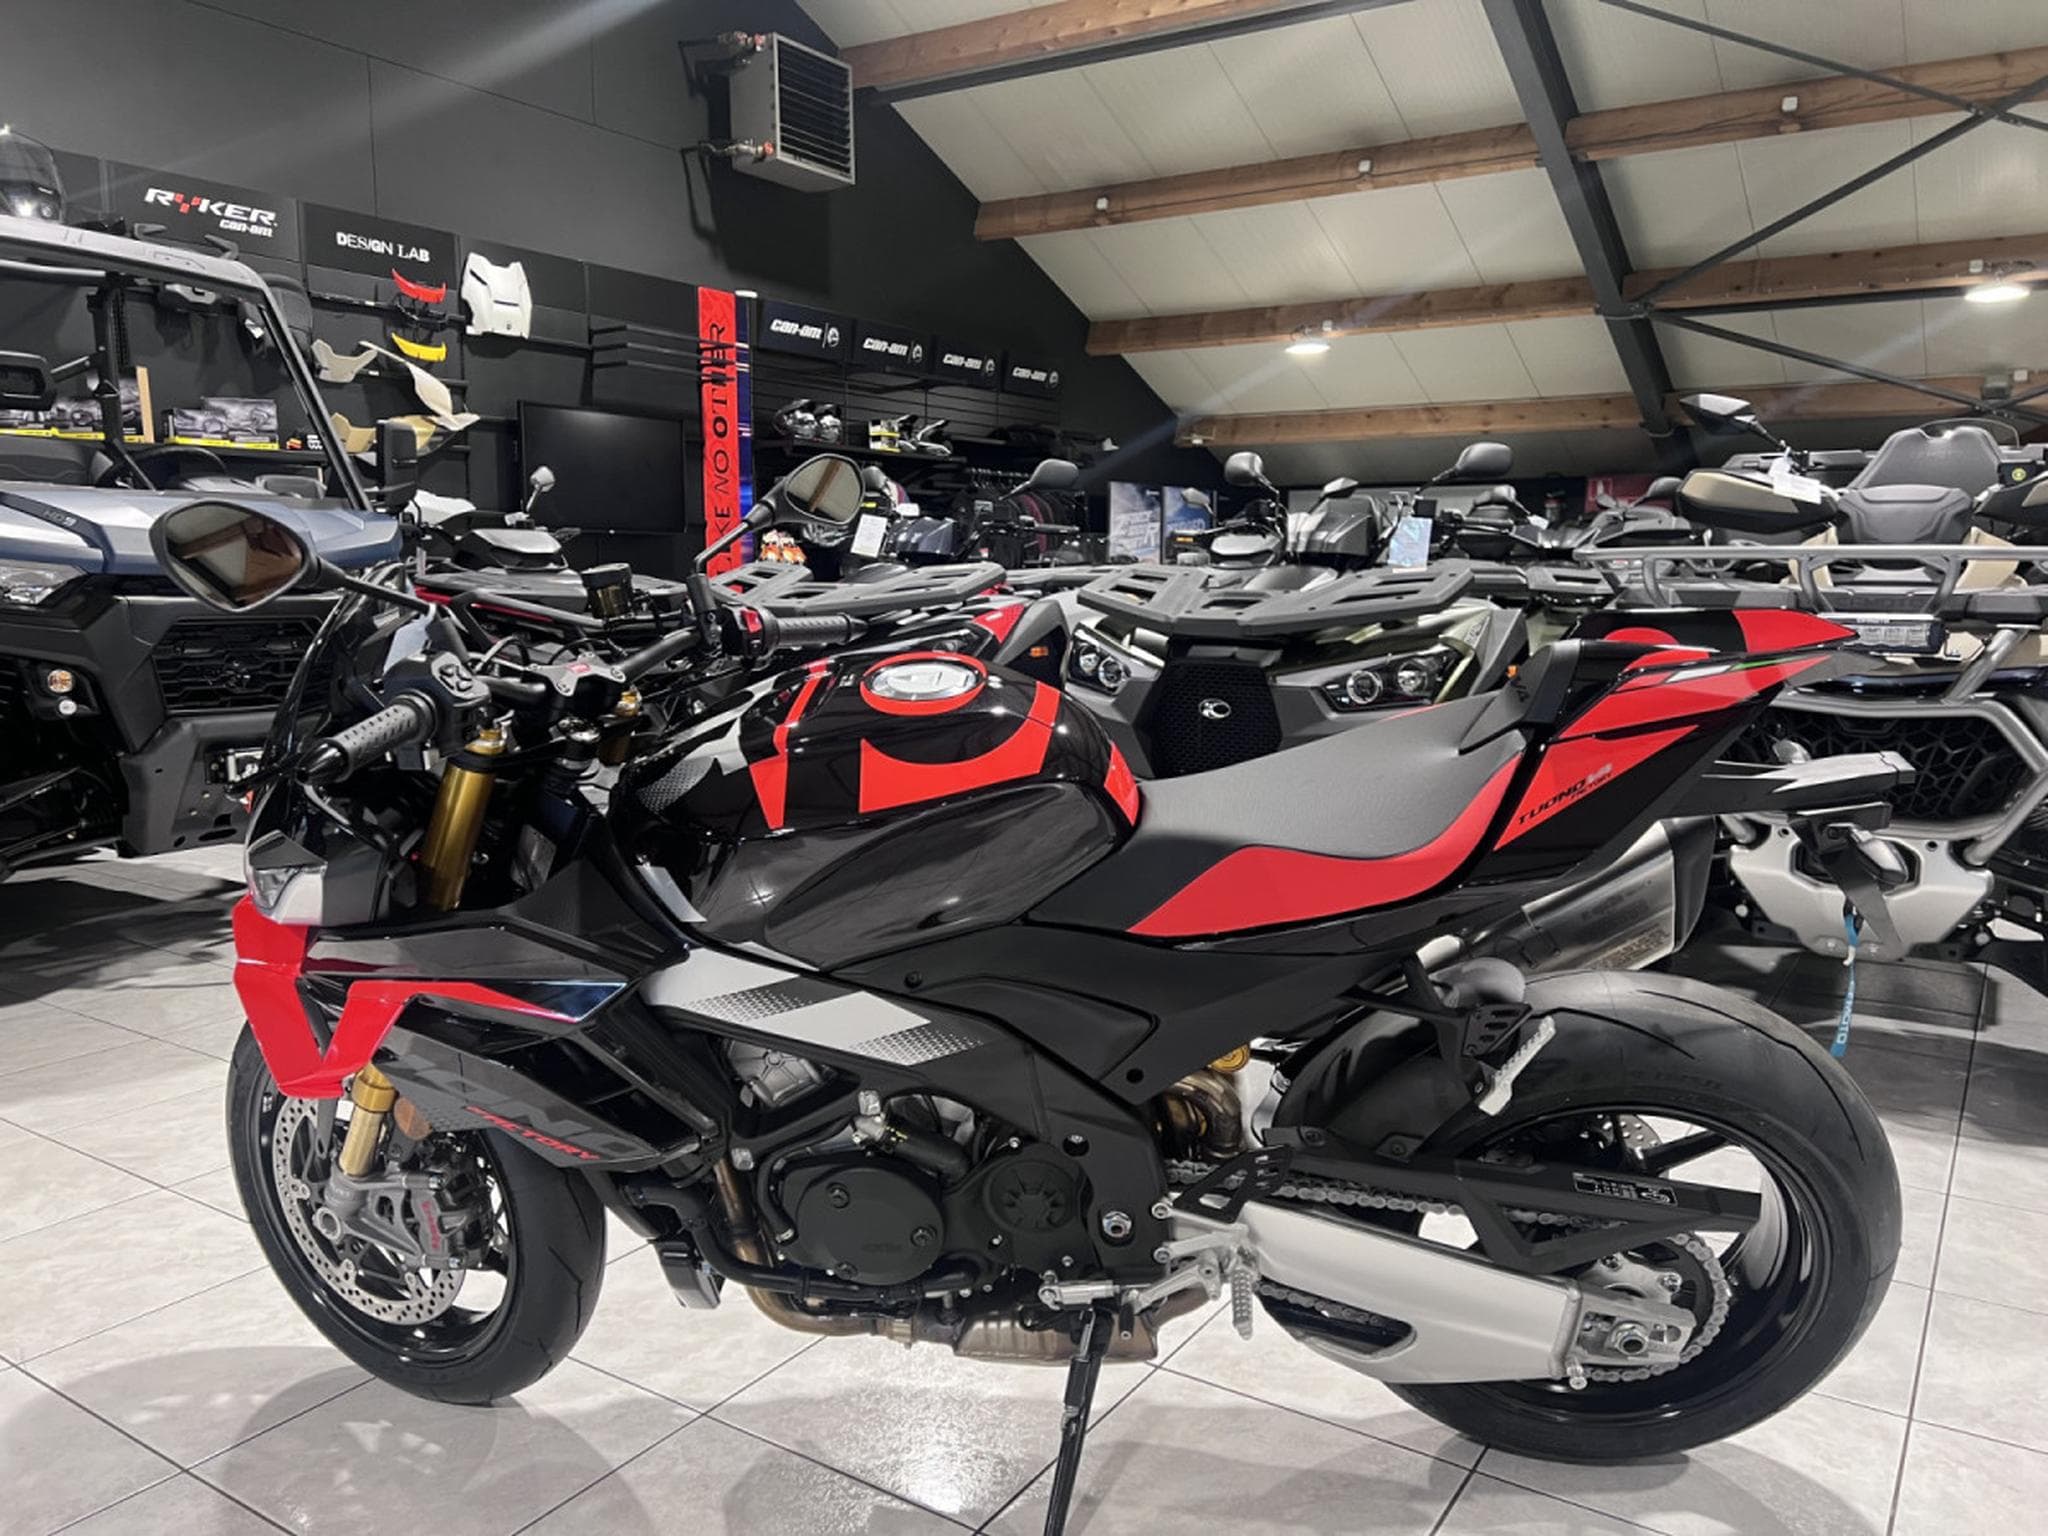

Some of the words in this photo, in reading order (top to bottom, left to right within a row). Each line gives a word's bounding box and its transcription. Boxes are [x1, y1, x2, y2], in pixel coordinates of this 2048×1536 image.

[144, 187, 275, 226] RYKER
[219, 219, 273, 238] can-am
[335, 231, 393, 256] DESIGN
[396, 243, 430, 262] LAB
[770, 318, 823, 340] can-am
[862, 337, 909, 356] can-am
[942, 353, 982, 370] can-am
[713, 450, 731, 495] NO
